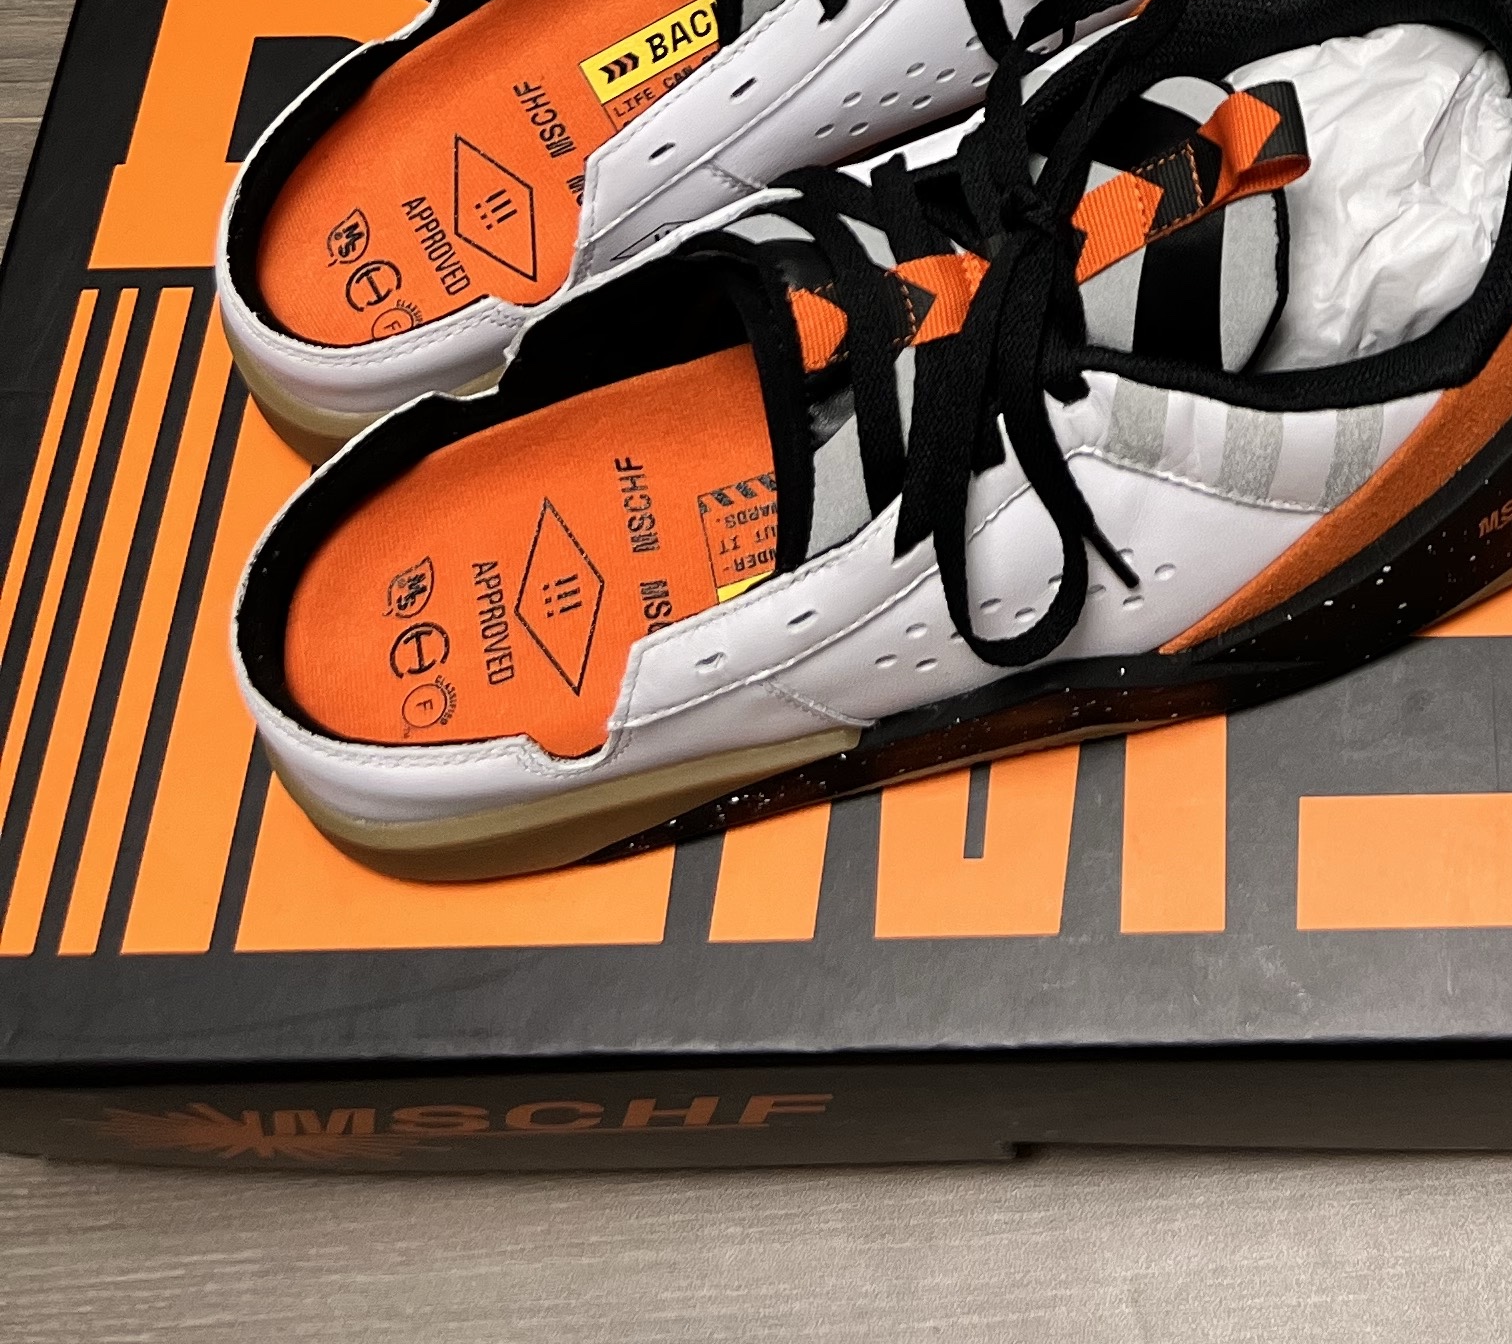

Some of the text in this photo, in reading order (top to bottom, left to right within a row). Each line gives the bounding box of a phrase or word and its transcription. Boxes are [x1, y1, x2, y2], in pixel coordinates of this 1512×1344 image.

[645, 1, 718, 64] BAC
[513, 76, 577, 159] MSCHF
[613, 87, 656, 118] LIFE
[402, 196, 472, 298] APPROVED
[614, 455, 660, 553] MSCHF
[471, 559, 515, 687] APPROVED
[270, 1093, 834, 1137] MSCHF
